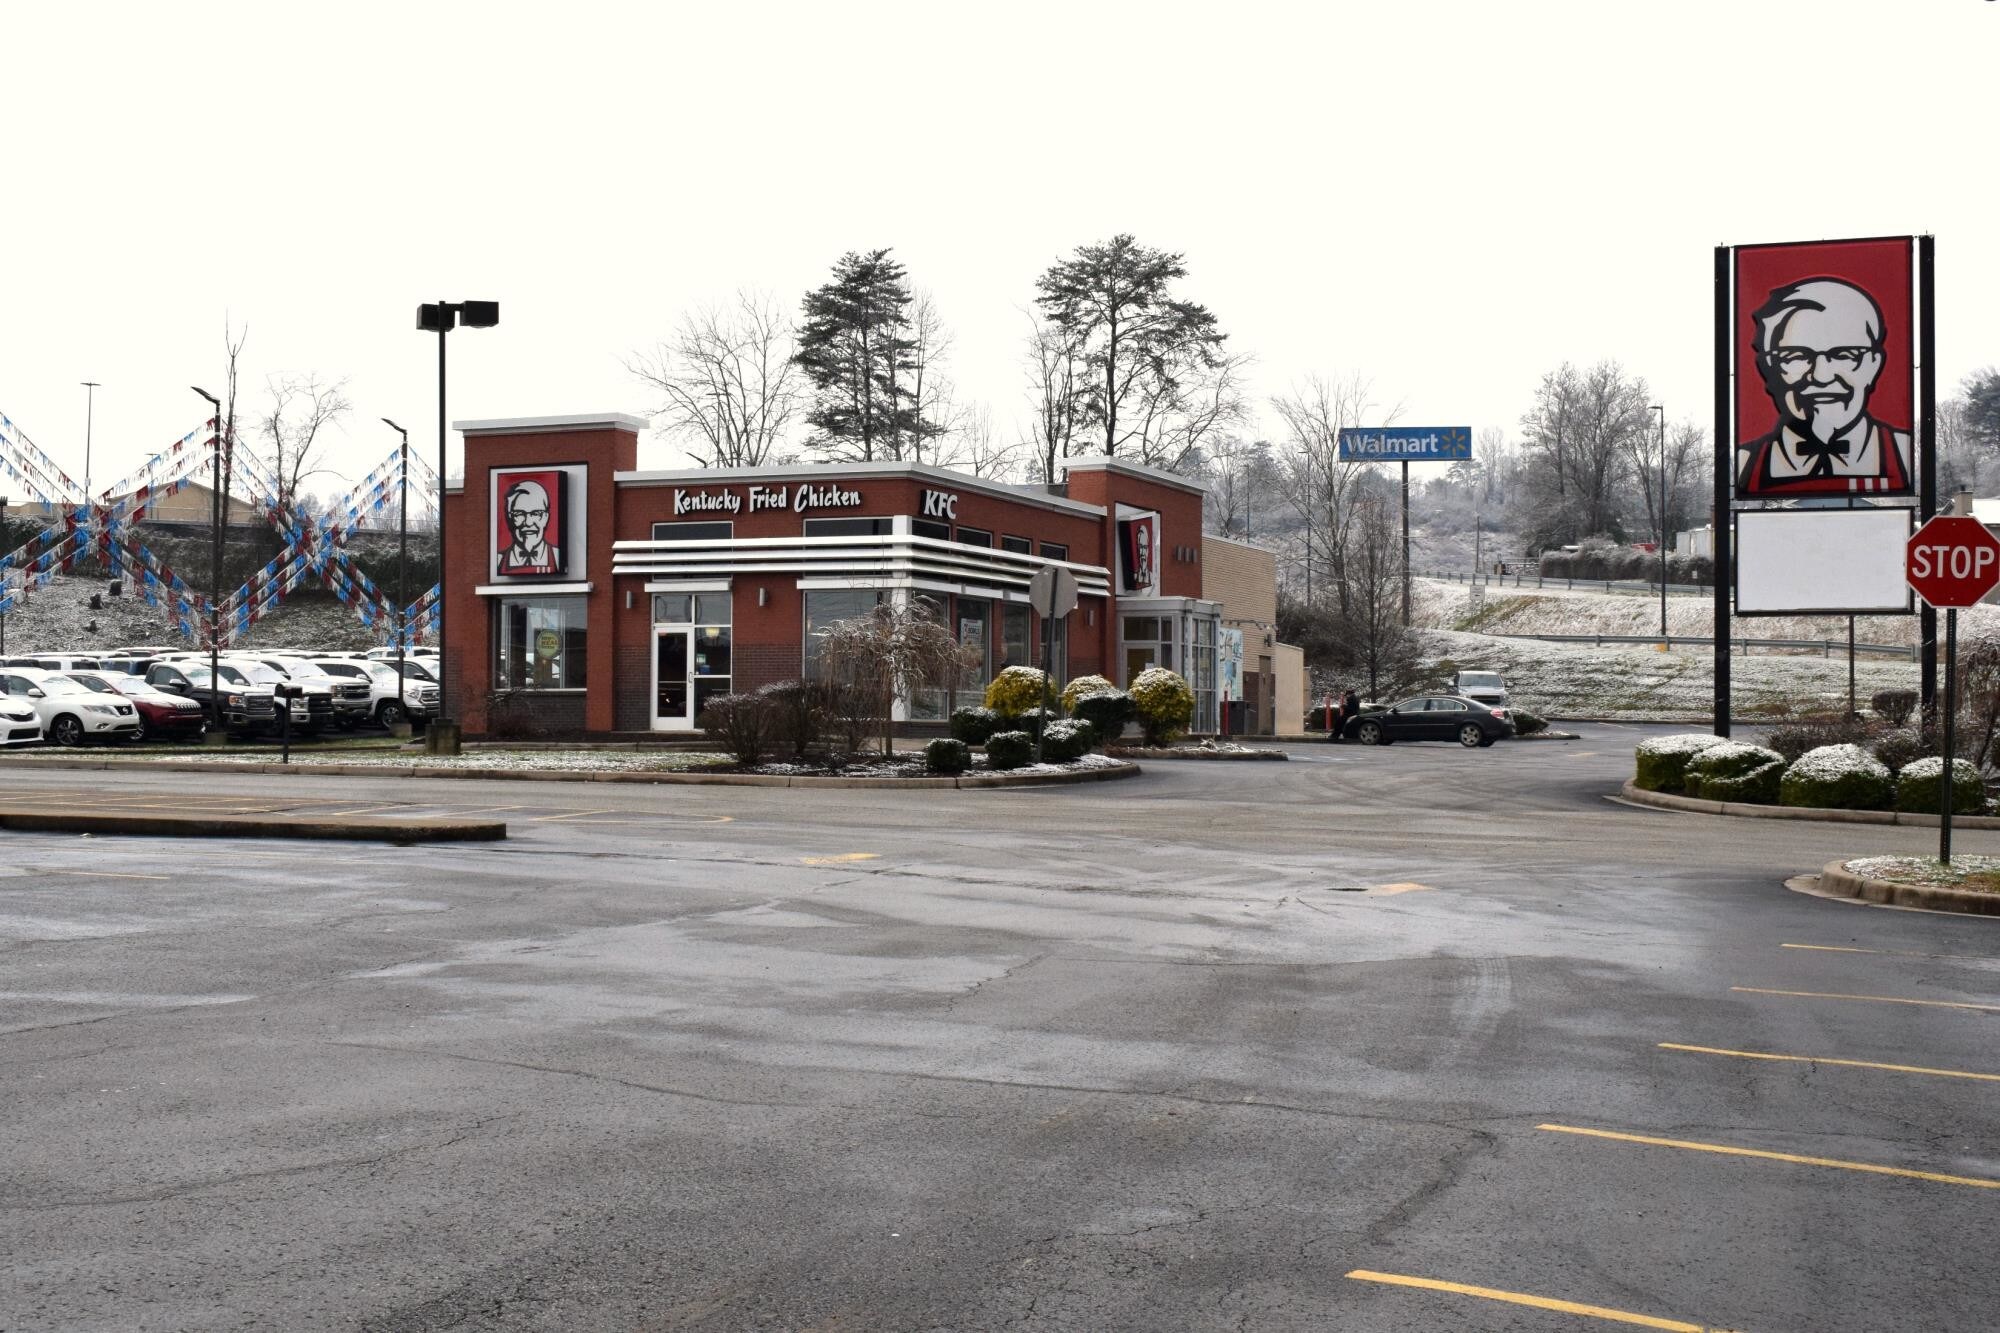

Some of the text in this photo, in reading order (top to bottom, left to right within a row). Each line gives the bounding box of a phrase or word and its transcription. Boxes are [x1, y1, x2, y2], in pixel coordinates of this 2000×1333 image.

[1345, 433, 1439, 453] Walmart
[674, 484, 861, 515] Kentucky Fried Chicken
[923, 489, 958, 520] KFC
[1911, 544, 1995, 579] STOP
